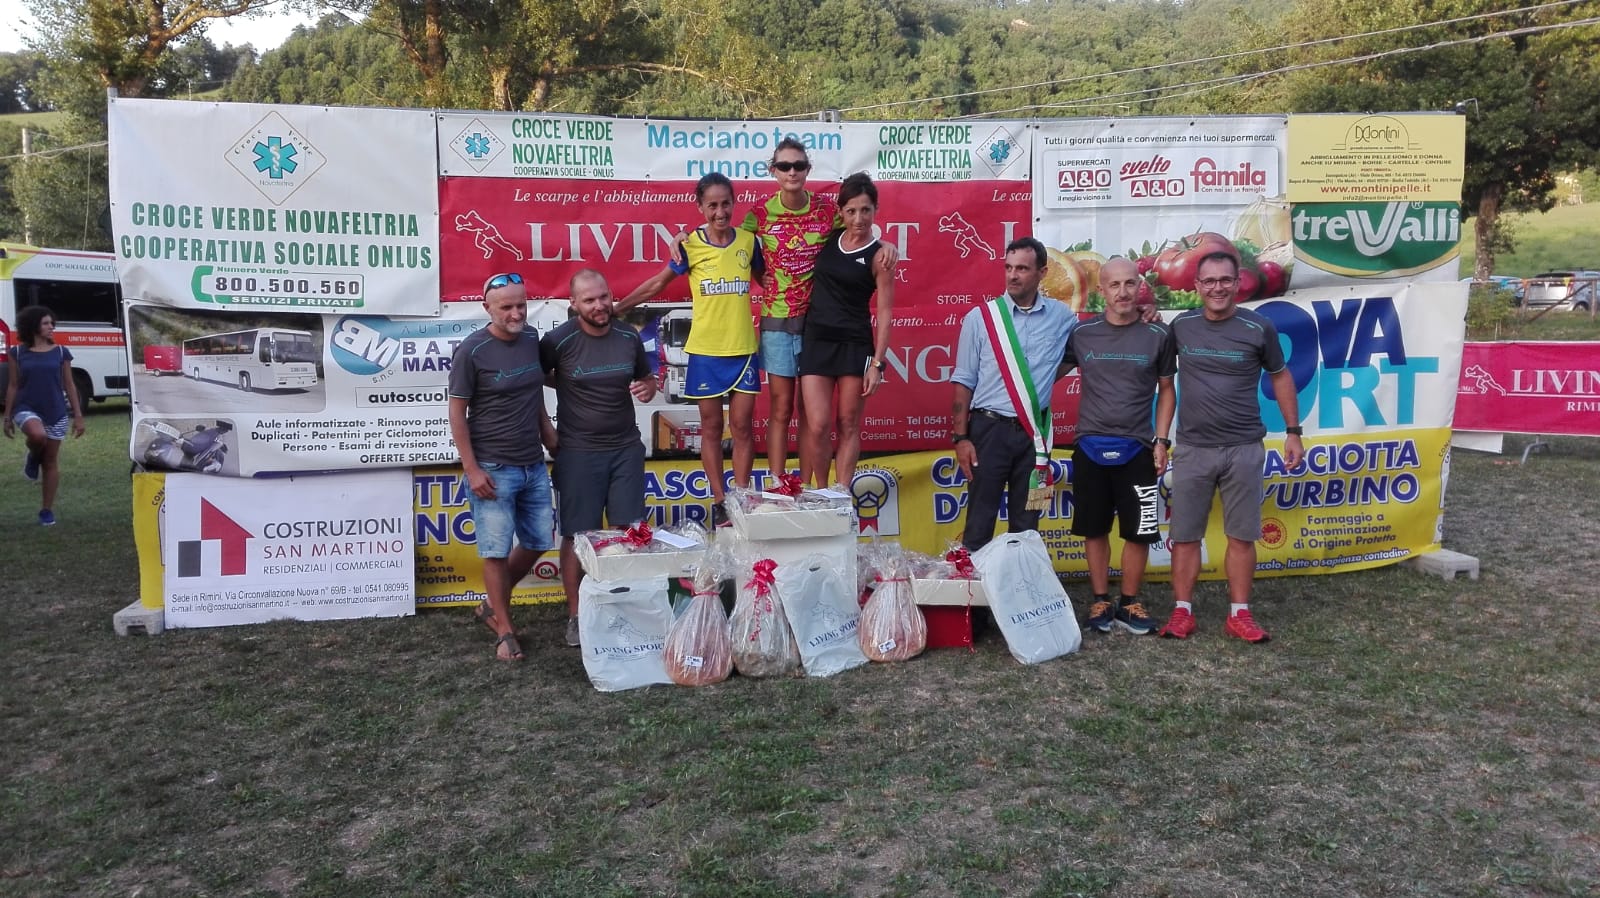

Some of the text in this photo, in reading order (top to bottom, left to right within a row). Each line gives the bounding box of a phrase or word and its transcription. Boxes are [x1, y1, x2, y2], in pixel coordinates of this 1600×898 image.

[512, 118, 562, 139] CROCE
[566, 119, 613, 141] VERDE
[647, 125, 768, 149] Maciano
[879, 125, 924, 145] CROCE
[928, 124, 972, 145] VERDE
[1044, 137, 1063, 145] Tutti
[1069, 136, 1095, 146] giorni
[1096, 135, 1124, 145] qualità
[1134, 135, 1187, 143] convenienza
[1203, 134, 1219, 142] tuoi
[512, 142, 613, 167] NOVAFELTRIA
[877, 148, 972, 169] NOVAFELTRIA
[687, 160, 777, 178] runne
[1057, 159, 1111, 167] SUPERMERCATI
[1120, 154, 1171, 176] svelto
[513, 166, 615, 178] COOPERATIVA SOCIALE ONLUS
[877, 171, 972, 180] COOPERATIVA SOCIALE ONLUS
[1058, 169, 1112, 188] A&O
[1190, 157, 1266, 192] famila
[1130, 178, 1185, 197] A&O
[1320, 183, 1432, 195] www.montinipelle.it
[513, 188, 697, 206] Le scarpe e l'abbigliamento
[736, 190, 757, 203] chi
[992, 190, 1010, 202] Le
[132, 202, 420, 237] CROCE VERDE NOVAFELTRIA
[526, 222, 688, 262] LIVIN
[120, 234, 432, 269] COOPERATIVA SOCIALE ONLUS
[216, 266, 290, 275] Numero Verde
[215, 276, 360, 295] 800.500.560
[231, 296, 355, 306] SERVIZI PRIVATI
[937, 295, 971, 304] STORE
[402, 357, 452, 372] MAR
[1511, 369, 1600, 394] LIVIN
[368, 388, 449, 403] autoscuol
[1566, 401, 1600, 412] RIMI
[255, 417, 449, 429] Aule informatizzate Rinnovo pate
[864, 415, 947, 426] Rimini Tel 0541
[251, 429, 447, 442] Duplicati Patentini per Ciclomotori
[860, 429, 946, 441] Cesena Tel 0547
[282, 440, 438, 452] Persone Esami di revisione
[360, 452, 454, 464] OFFERTE SPECIALI
[1264, 439, 1421, 479] ACIOTTA
[1262, 473, 1420, 510] 'URBINO
[1133, 484, 1159, 535] EVERLAST
[1307, 513, 1385, 526] Formaggio a
[263, 517, 402, 540] COSTRUZIONI
[1300, 523, 1392, 538] Denominazione
[263, 539, 404, 559] SAN MARTINO
[1293, 533, 1397, 551] di Origine Protetta
[1056, 550, 1088, 561] Prote
[1256, 560, 1284, 571] scolo,
[1287, 558, 1311, 569] latte
[1320, 555, 1362, 568] sapienza
[263, 560, 403, 575] RESIDENZIALI COMMERCIALI
[171, 593, 190, 603] Sede
[191, 593, 198, 602] in
[225, 591, 237, 600] Via
[238, 588, 295, 600] Circonvallazione
[296, 588, 319, 597] Nuova
[429, 590, 489, 603] contadina
[808, 629, 839, 648] LIVING
[594, 646, 632, 655] LIVING
